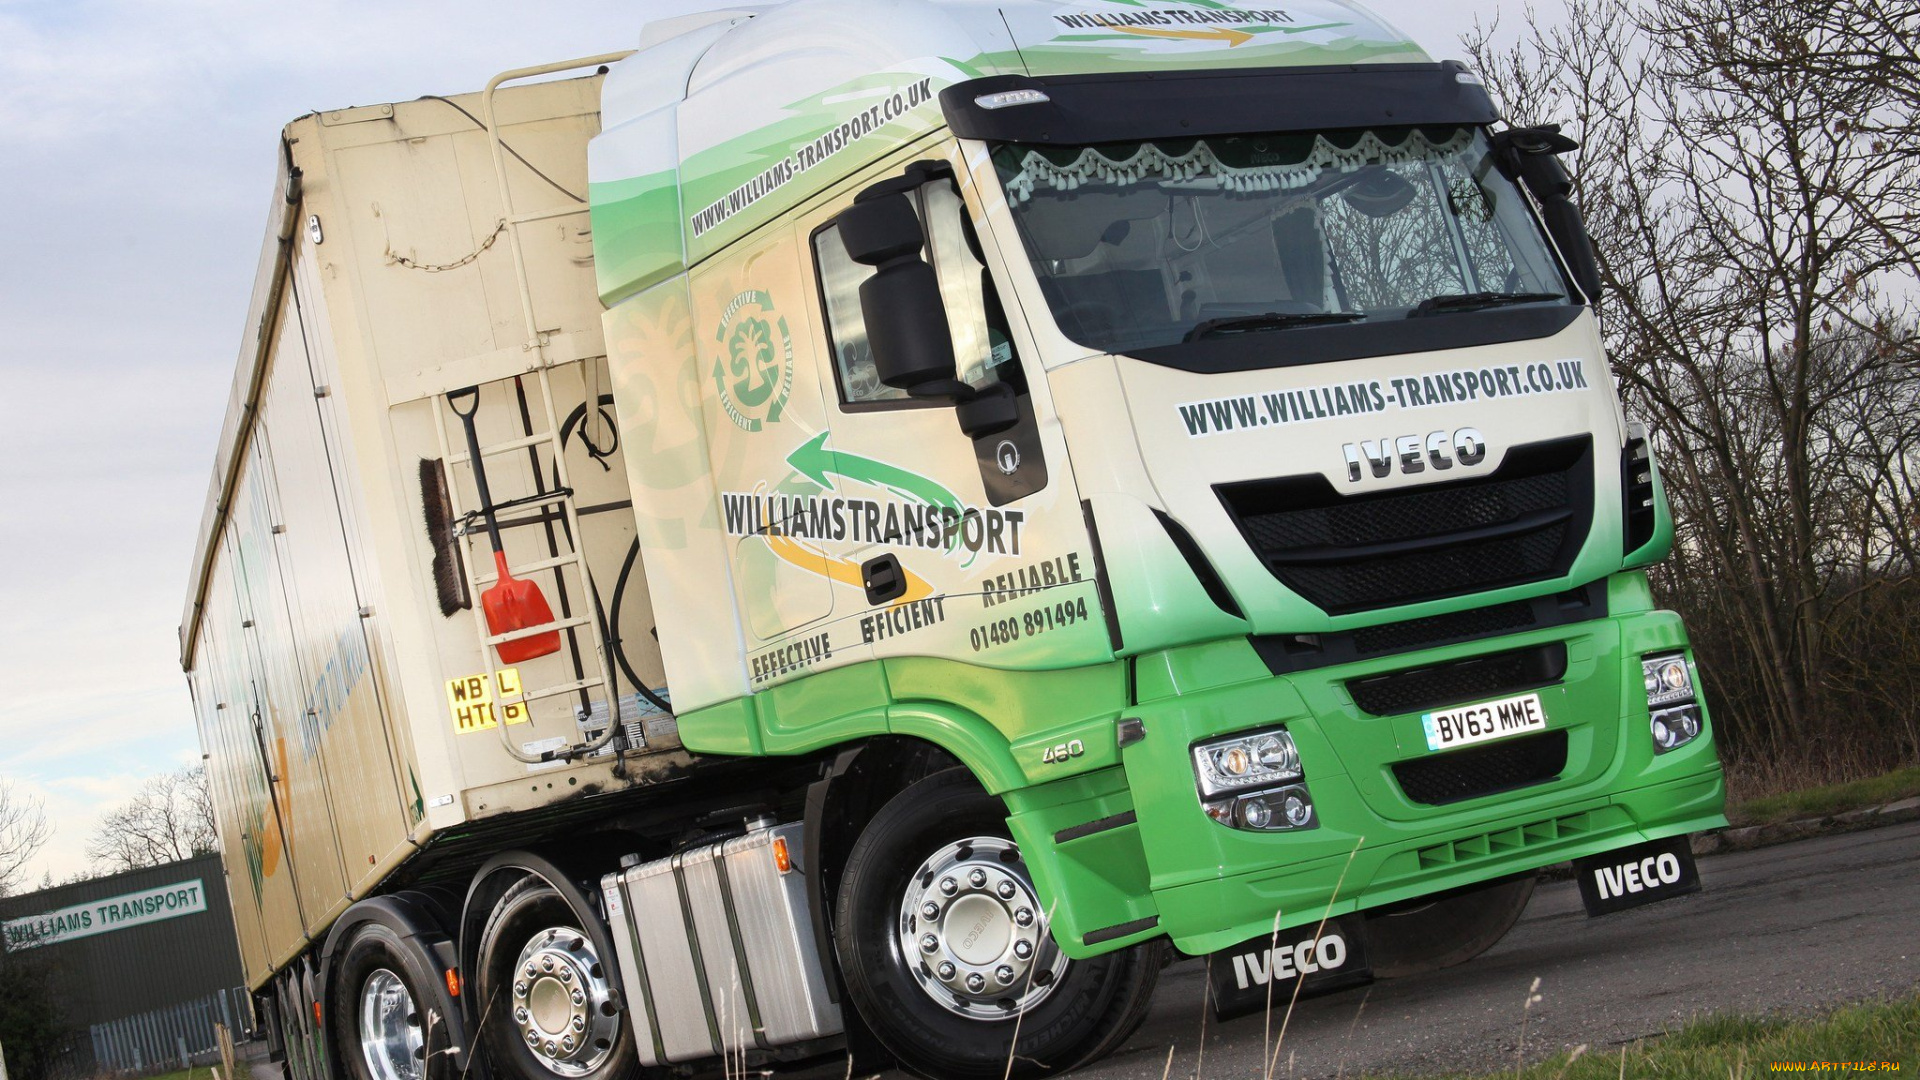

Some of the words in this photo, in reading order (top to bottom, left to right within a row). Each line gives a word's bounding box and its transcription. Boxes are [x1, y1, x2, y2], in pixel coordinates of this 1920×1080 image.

[692, 78, 932, 237] WWW.WILLIAMS-TRANSPORT.CO.UK
[721, 290, 757, 328] EFFECTIVE
[781, 335, 793, 398] RELIABLE
[720, 389, 752, 431] EFFICIENT
[1180, 361, 1588, 436] WWW.WILLIAMS-TRANSPORT.CO.UK
[1341, 427, 1486, 483] IVECO
[982, 553, 1082, 608] RELIABLE
[860, 594, 947, 645] EFFICIENT
[970, 617, 1020, 652] 01480
[1023, 597, 1088, 635] 891494
[752, 632, 833, 683] EFFECTIVE
[451, 673, 515, 702] WBL
[1437, 708, 1494, 742] BV63
[1497, 699, 1539, 730] MME
[1594, 852, 1681, 900] IVECO
[8, 911, 92, 942] WILLIAMS
[96, 887, 198, 926] TRANSPORT
[1232, 934, 1347, 990] IVECO
